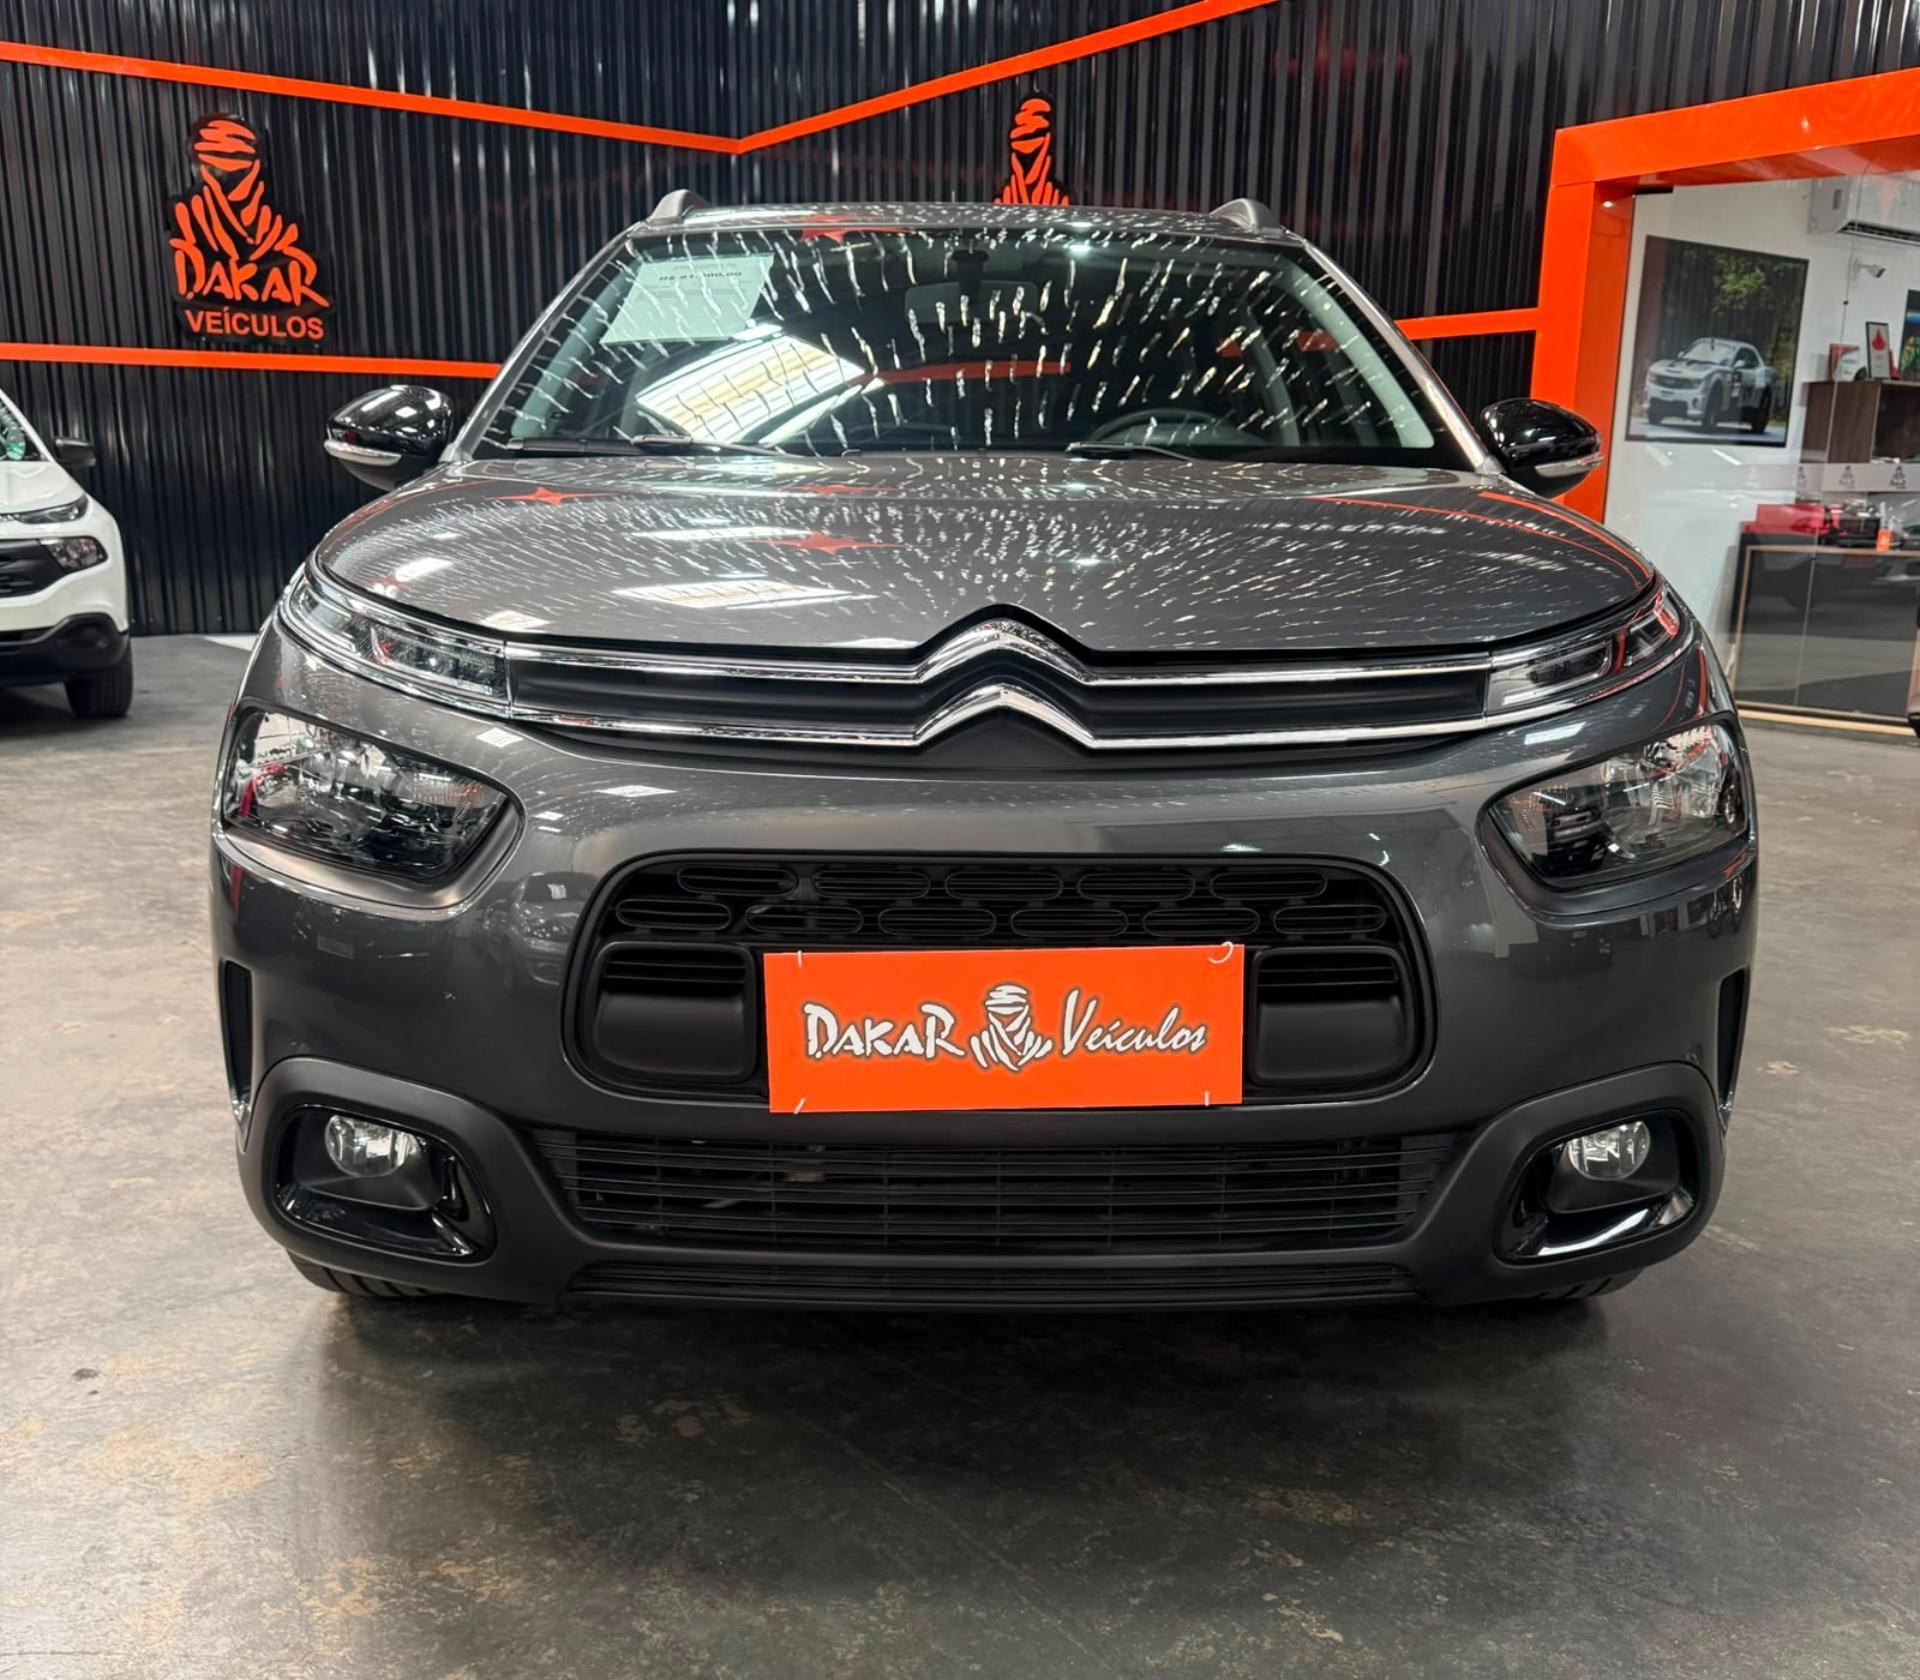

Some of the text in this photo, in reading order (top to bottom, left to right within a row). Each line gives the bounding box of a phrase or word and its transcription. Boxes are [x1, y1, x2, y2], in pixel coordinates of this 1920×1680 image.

[169, 237, 331, 307] DAKAR
[185, 307, 324, 339] VEÍCULOS
[803, 988, 1207, 1060] DAKAR Veículos
